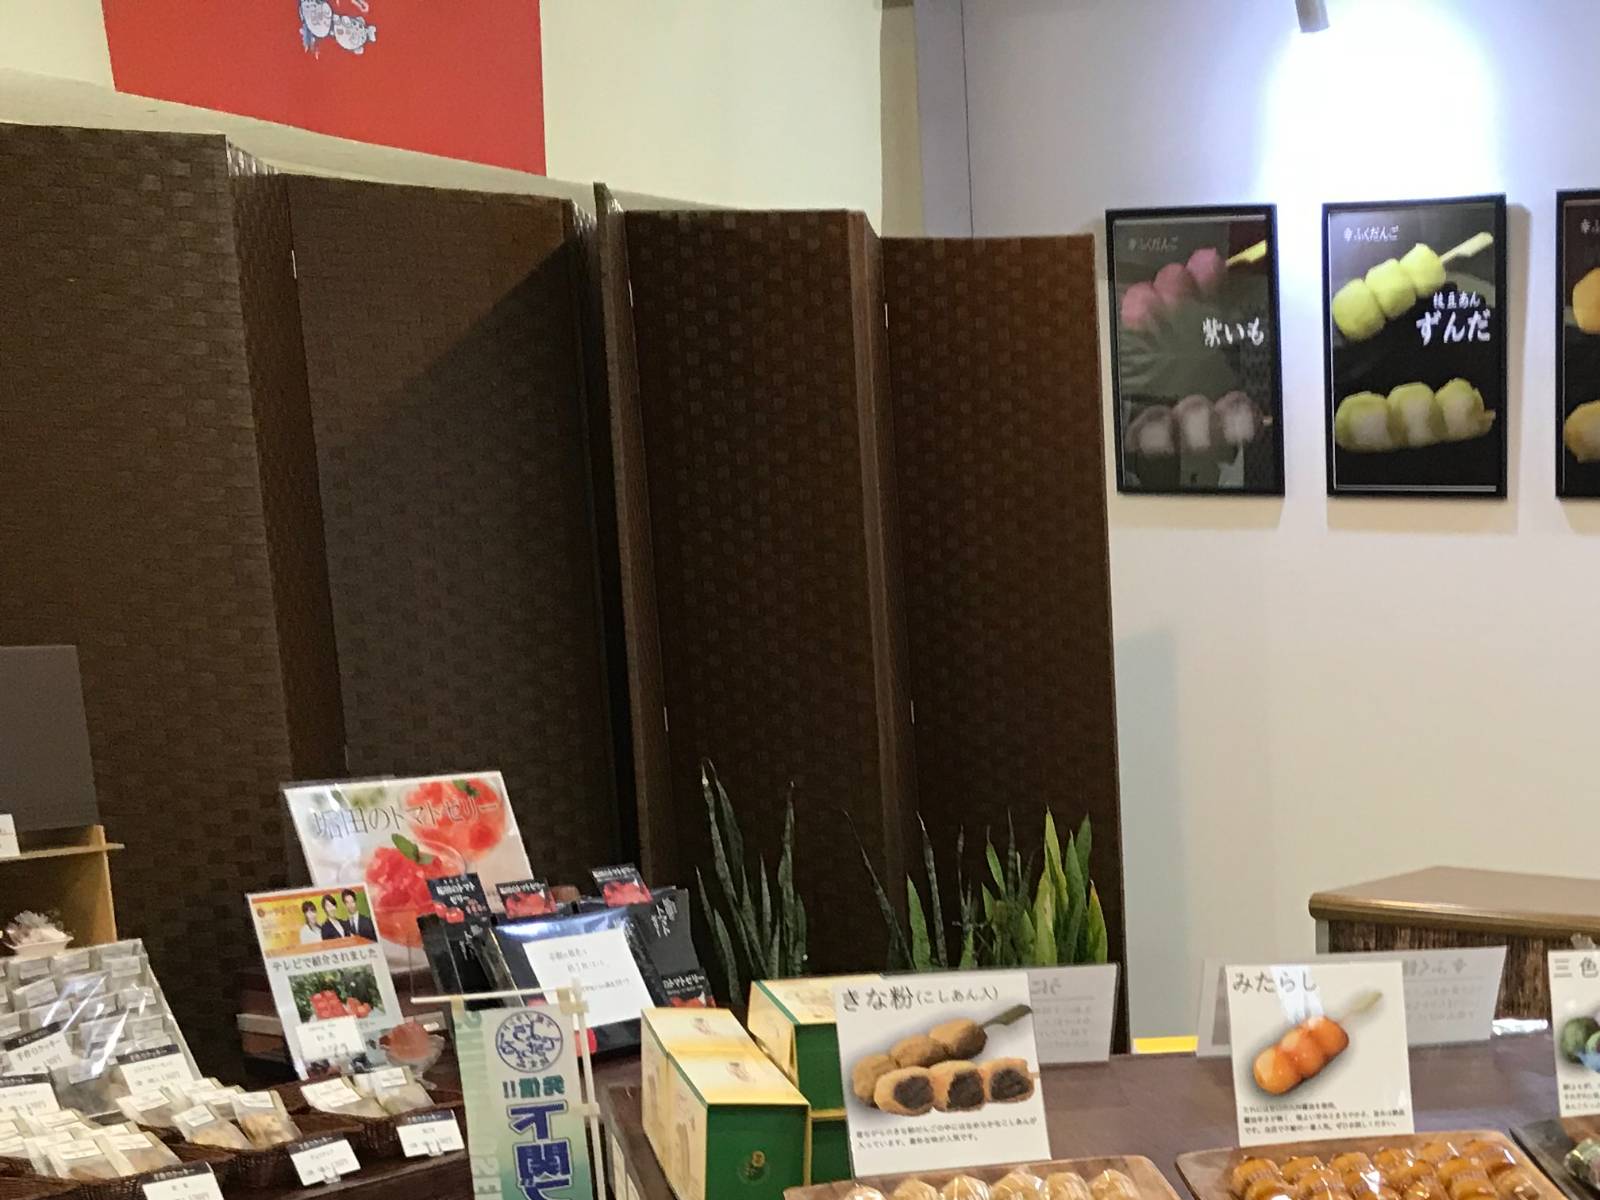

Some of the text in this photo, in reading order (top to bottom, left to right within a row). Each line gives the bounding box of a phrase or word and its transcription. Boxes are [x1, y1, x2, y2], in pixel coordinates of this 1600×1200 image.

[1202, 316, 1265, 348] 紫いも
[1415, 307, 1491, 346] ずんだ
[272, 950, 380, 972] テレビで紹介されました
[1232, 972, 1318, 994] みたらし
